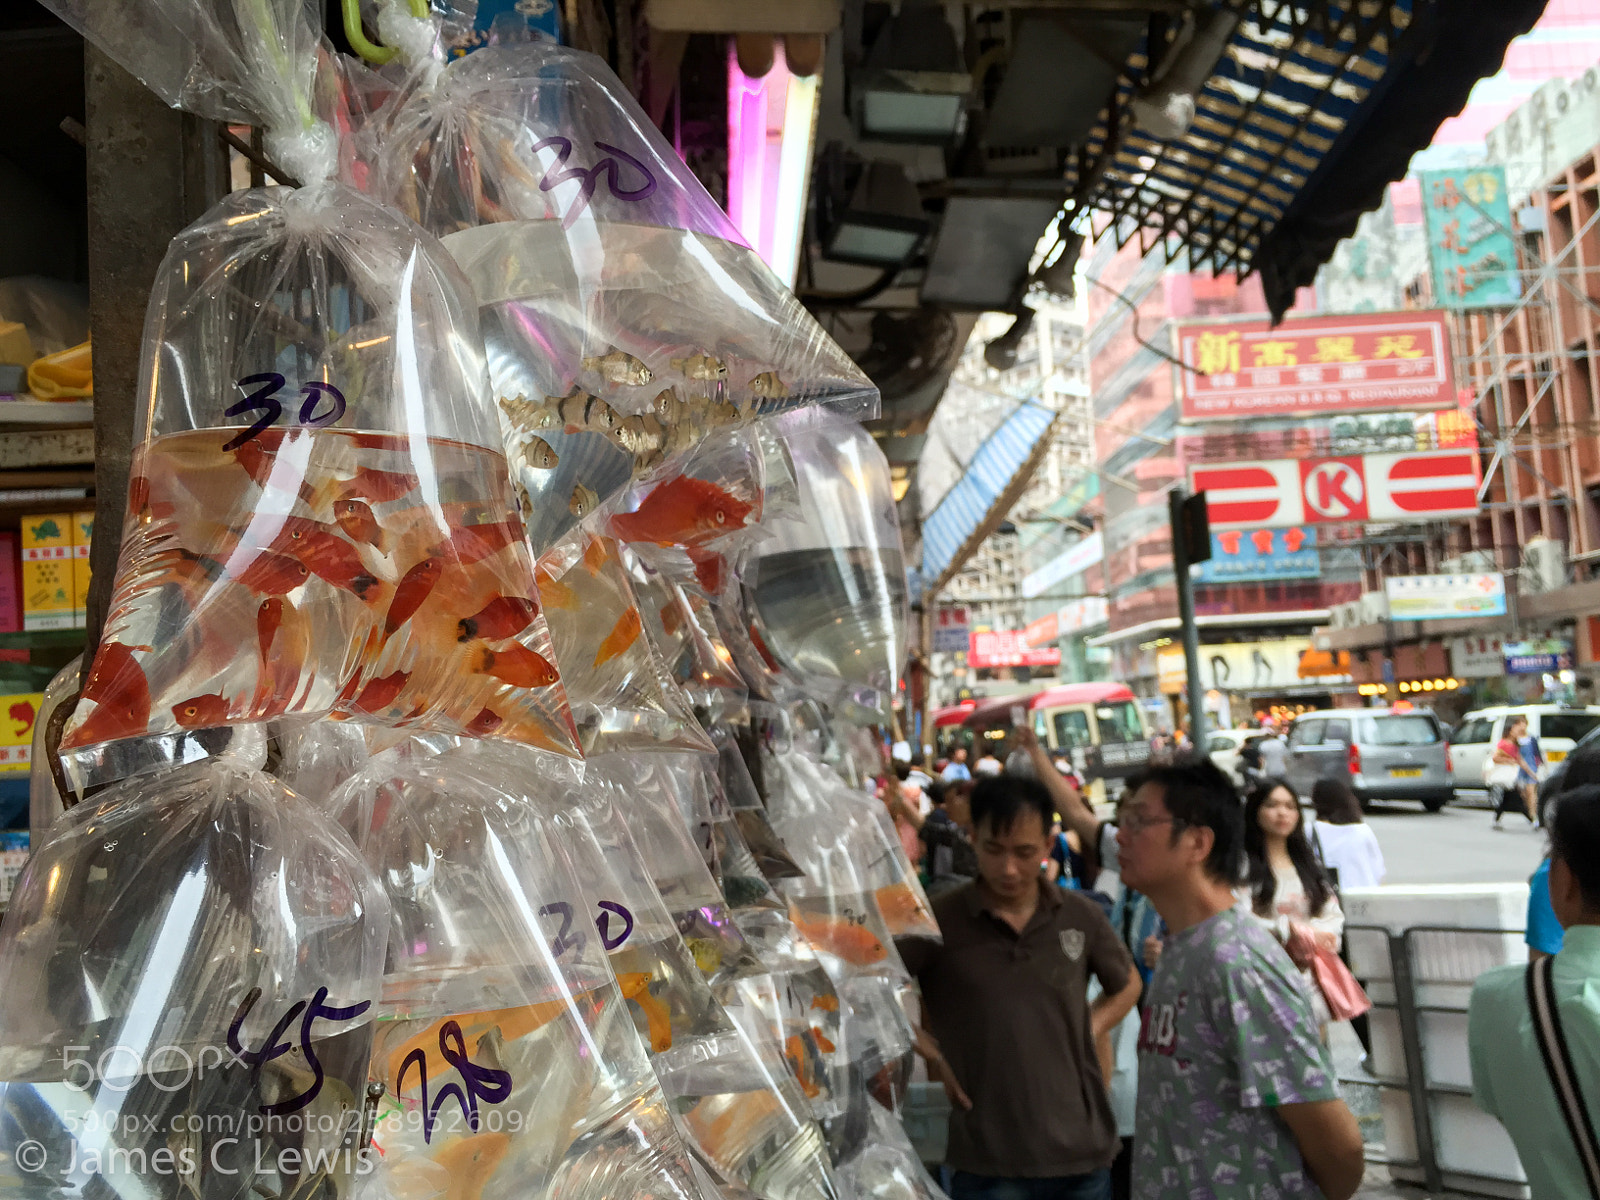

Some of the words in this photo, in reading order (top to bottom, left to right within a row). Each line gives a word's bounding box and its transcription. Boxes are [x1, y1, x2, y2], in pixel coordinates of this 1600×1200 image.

[531, 136, 657, 230] 30
[222, 372, 347, 452] 30
[227, 986, 372, 1116] 45
